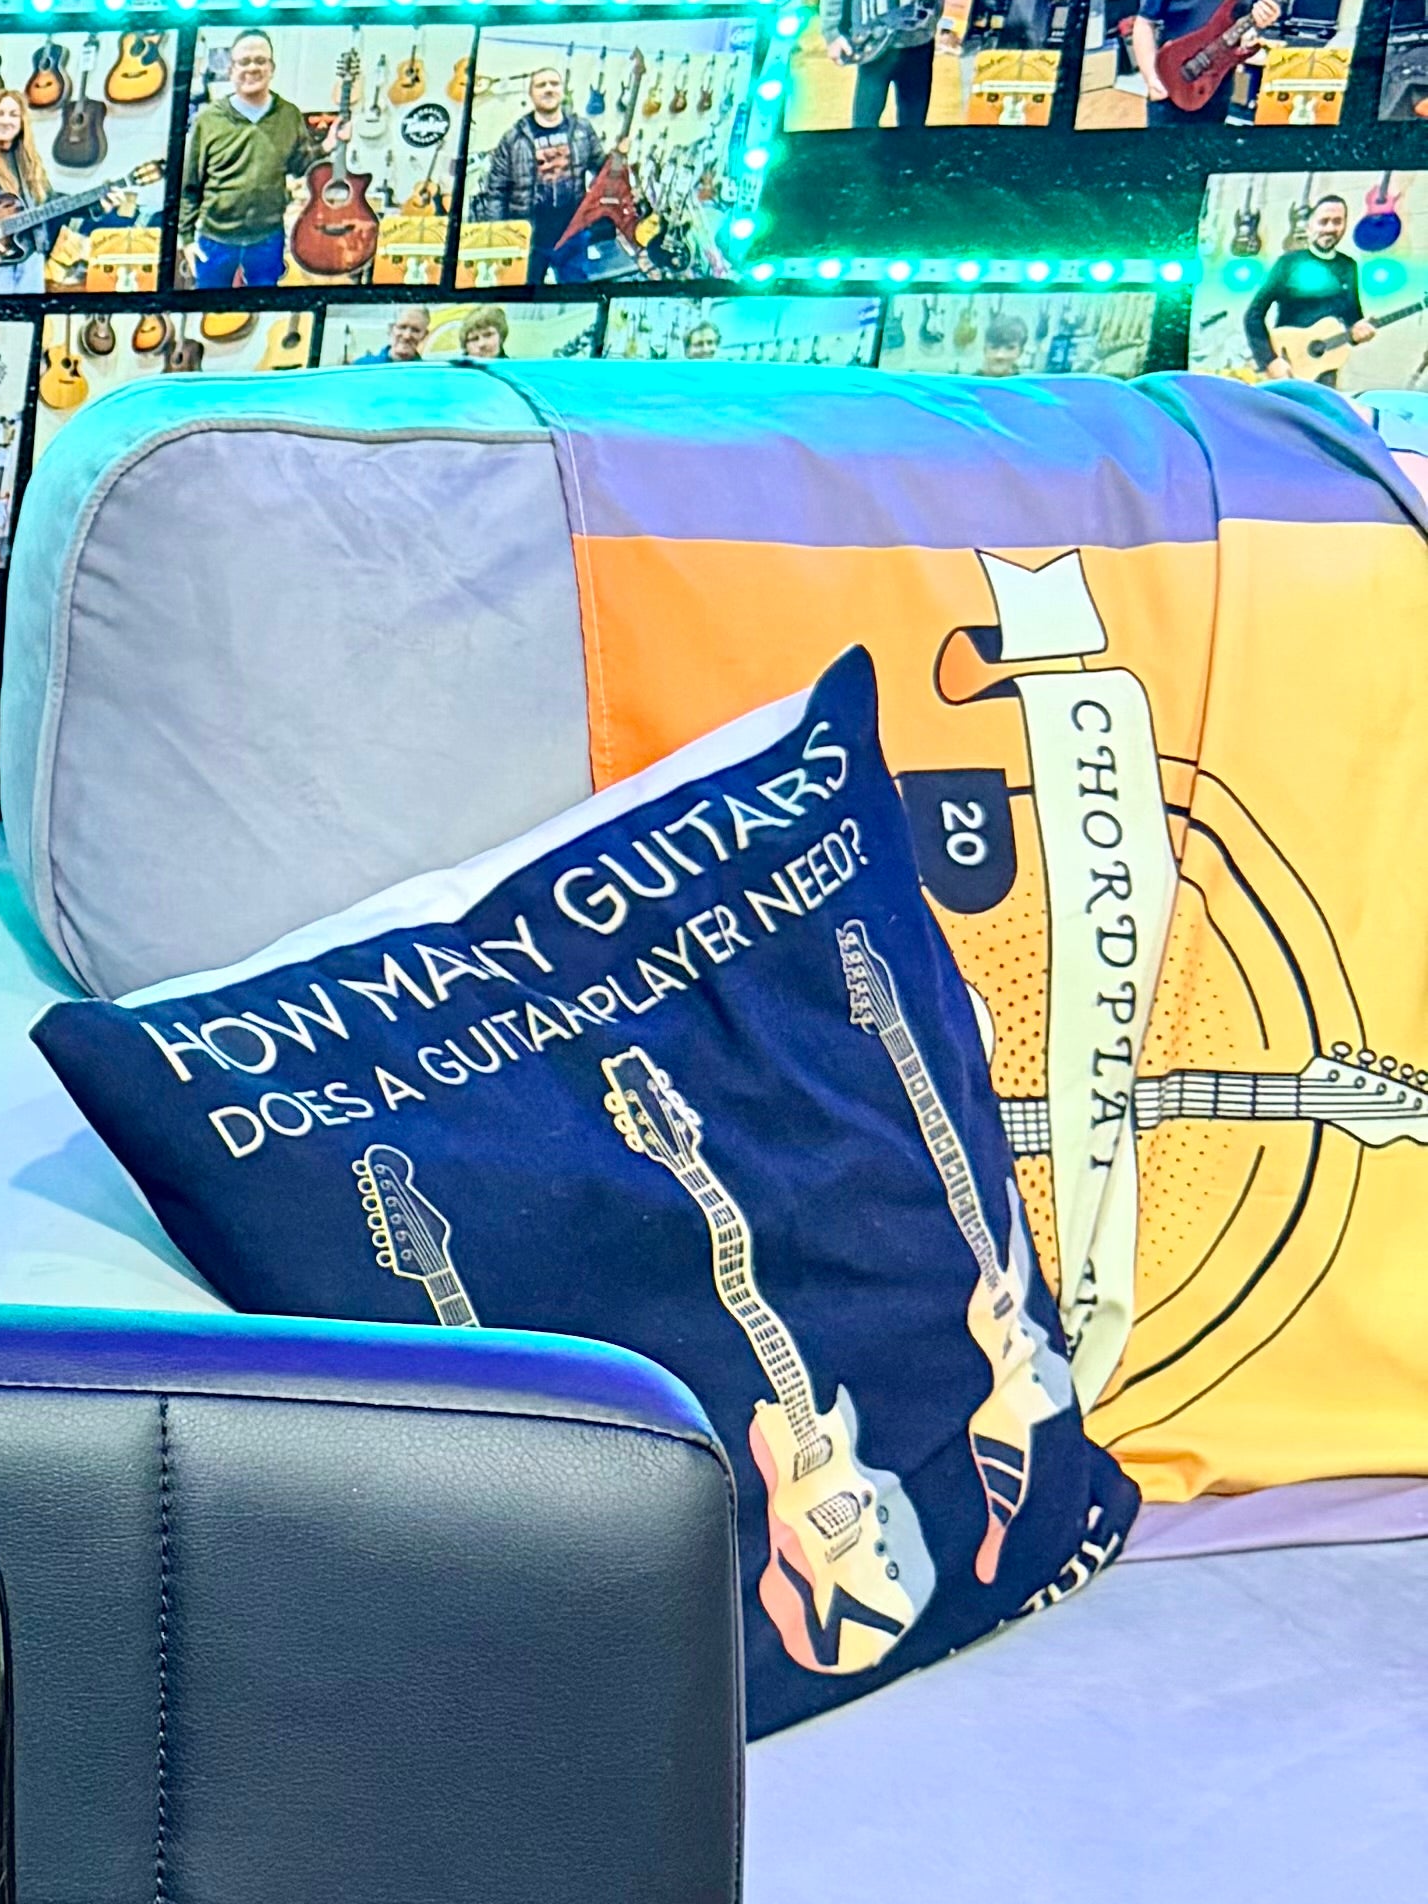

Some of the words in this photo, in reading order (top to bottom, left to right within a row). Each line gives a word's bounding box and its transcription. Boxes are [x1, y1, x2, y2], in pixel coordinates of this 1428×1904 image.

[139, 973, 348, 1082] HOW
[340, 915, 555, 1024] MANY
[553, 719, 852, 936] GUITARS
[208, 1080, 375, 1159] DOES
[383, 1065, 426, 1112] A
[754, 817, 871, 937] NEED?
[942, 800, 985, 867] 20
